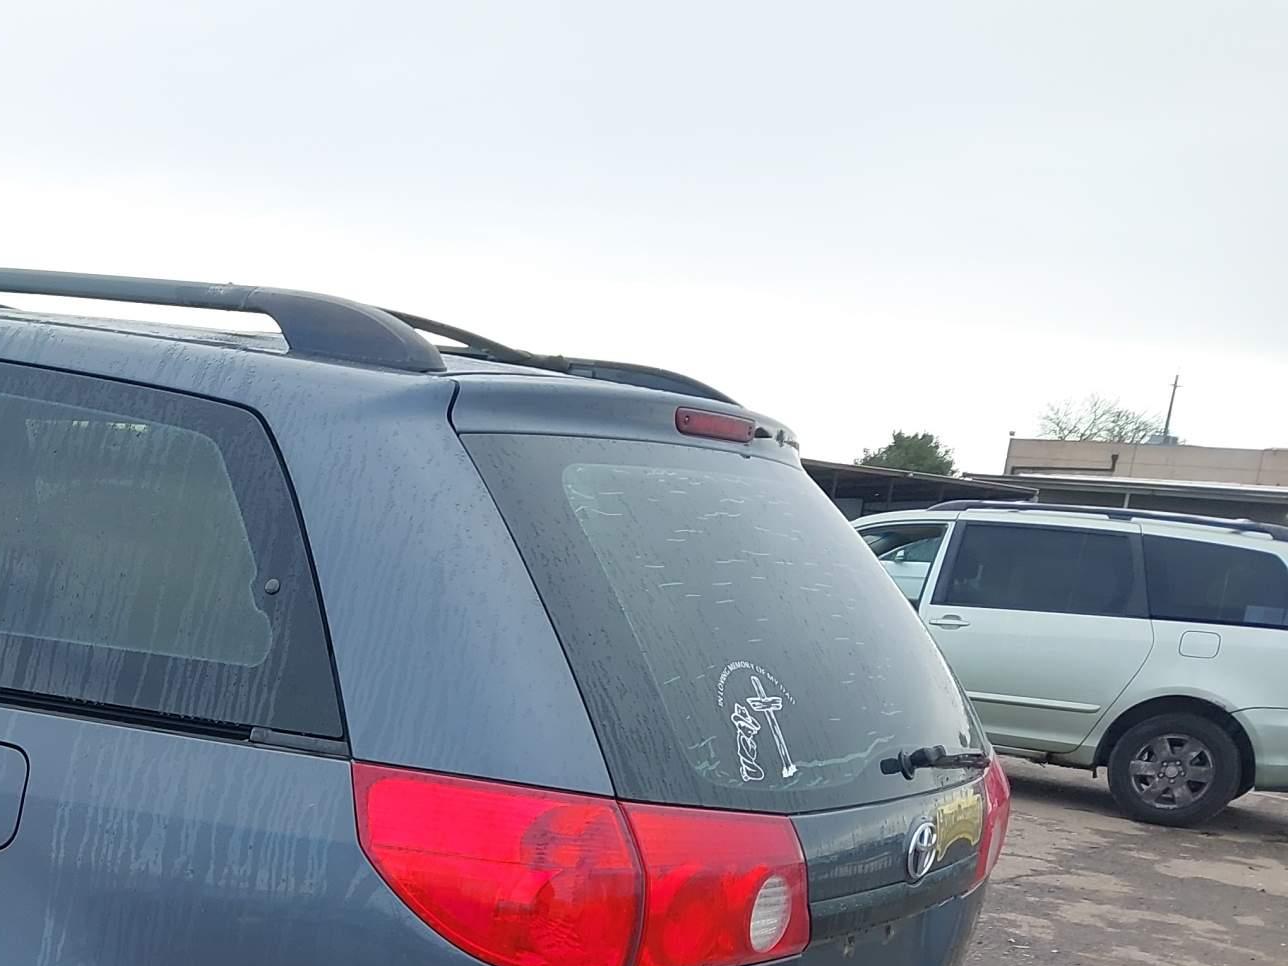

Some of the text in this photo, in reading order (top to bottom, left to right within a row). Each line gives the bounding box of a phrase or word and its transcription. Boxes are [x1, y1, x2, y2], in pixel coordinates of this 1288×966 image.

[717, 667, 730, 696] LOVING
[727, 660, 754, 672] MEMORY
[755, 665, 765, 675] OF
